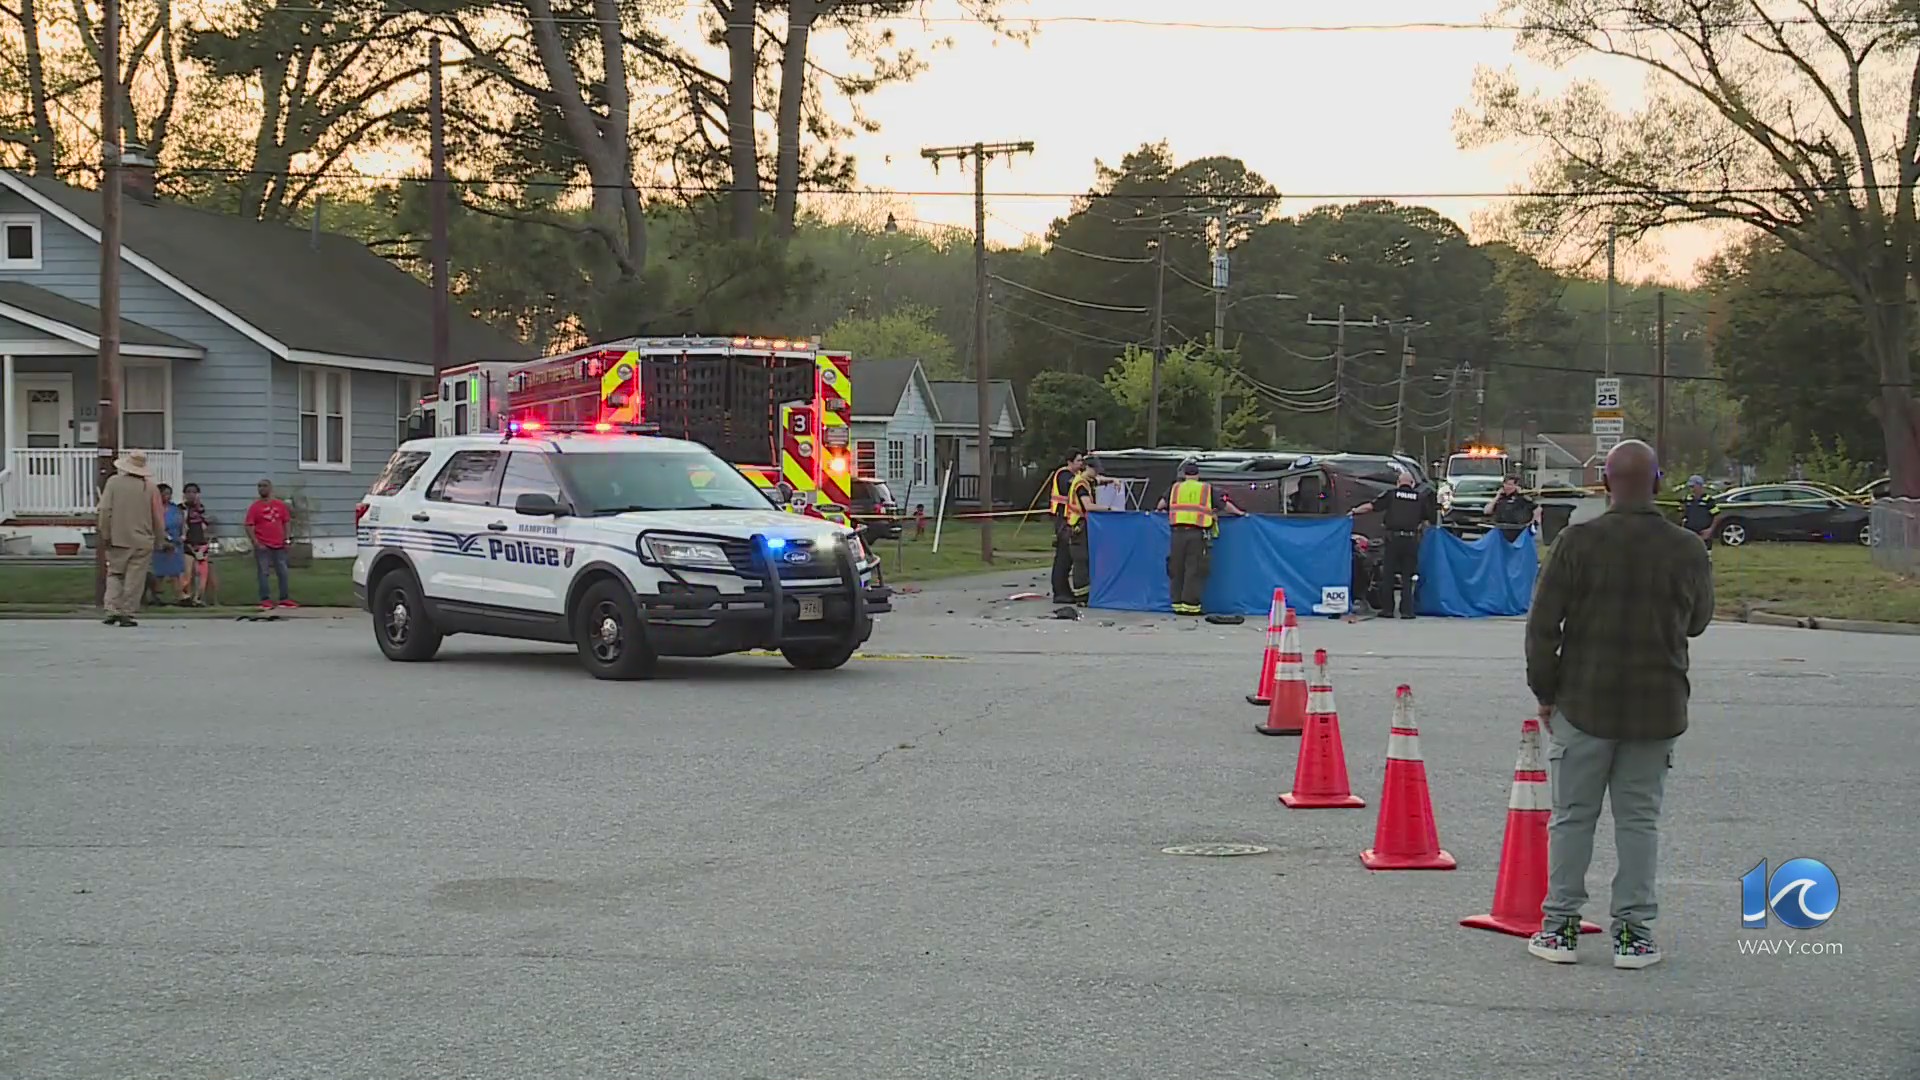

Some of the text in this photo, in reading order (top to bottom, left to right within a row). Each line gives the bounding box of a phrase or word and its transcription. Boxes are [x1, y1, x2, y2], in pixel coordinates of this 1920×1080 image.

[1598, 394, 1617, 406] 25
[794, 414, 806, 432] 3
[1396, 491, 1418, 500] POLICE
[518, 524, 558, 535] HAMPTON
[488, 538, 560, 567] Police
[791, 552, 806, 561] Ford
[1326, 591, 1346, 600] ADG
